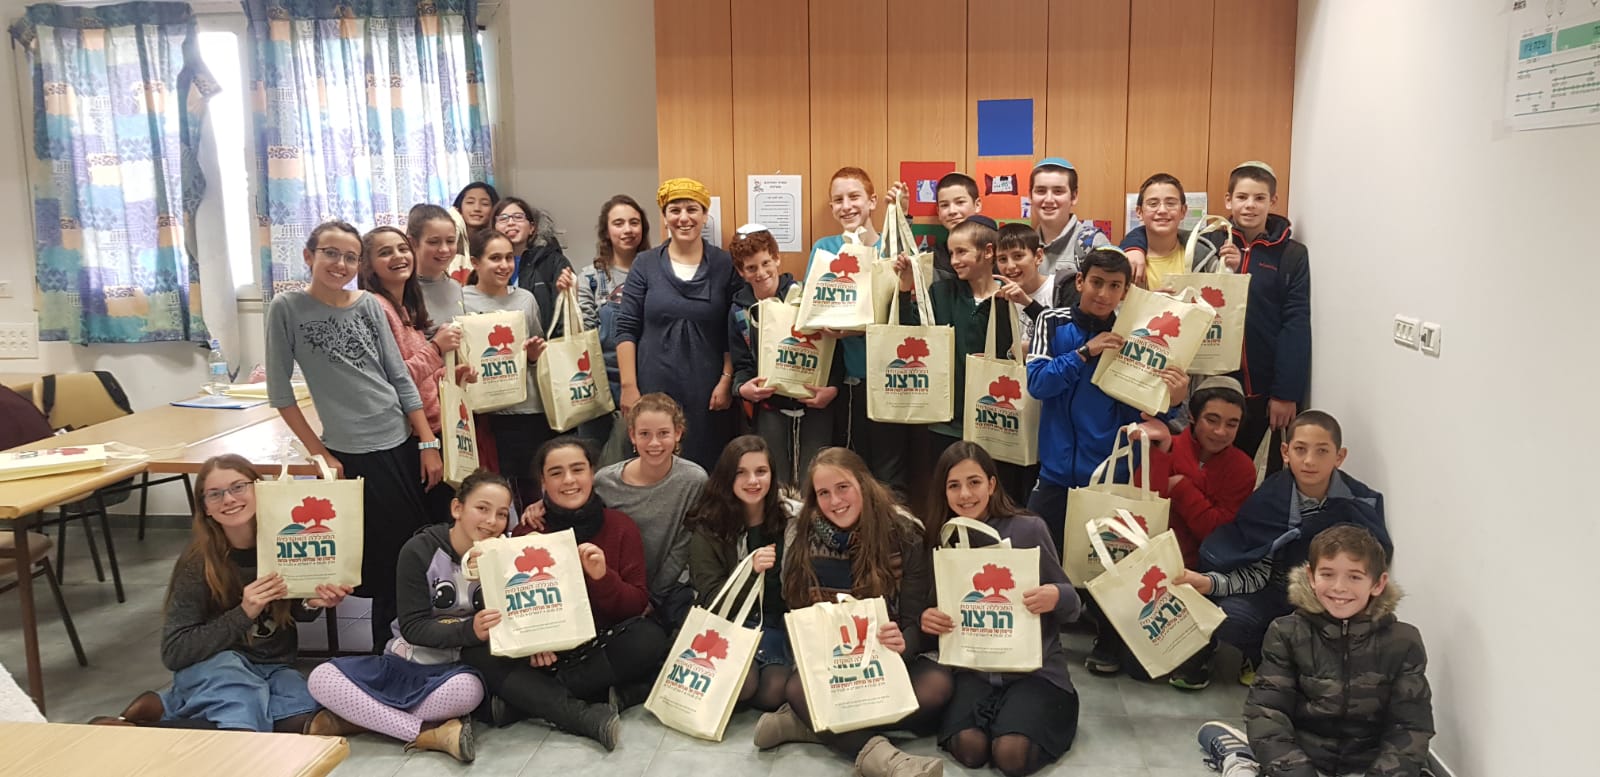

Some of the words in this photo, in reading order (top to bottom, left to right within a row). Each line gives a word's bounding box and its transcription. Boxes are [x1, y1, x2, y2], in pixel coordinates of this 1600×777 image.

[813, 287, 857, 301] הרצוג
[481, 360, 517, 377] הרצוג
[776, 349, 818, 369] הרצוג
[885, 373, 929, 388] הרצוג
[976, 408, 1019, 429] הרצוג
[277, 540, 336, 558] הרצוג
[506, 587, 562, 612] הרצוג
[961, 610, 1013, 629] הרצוג
[667, 664, 711, 693] הרצוג
